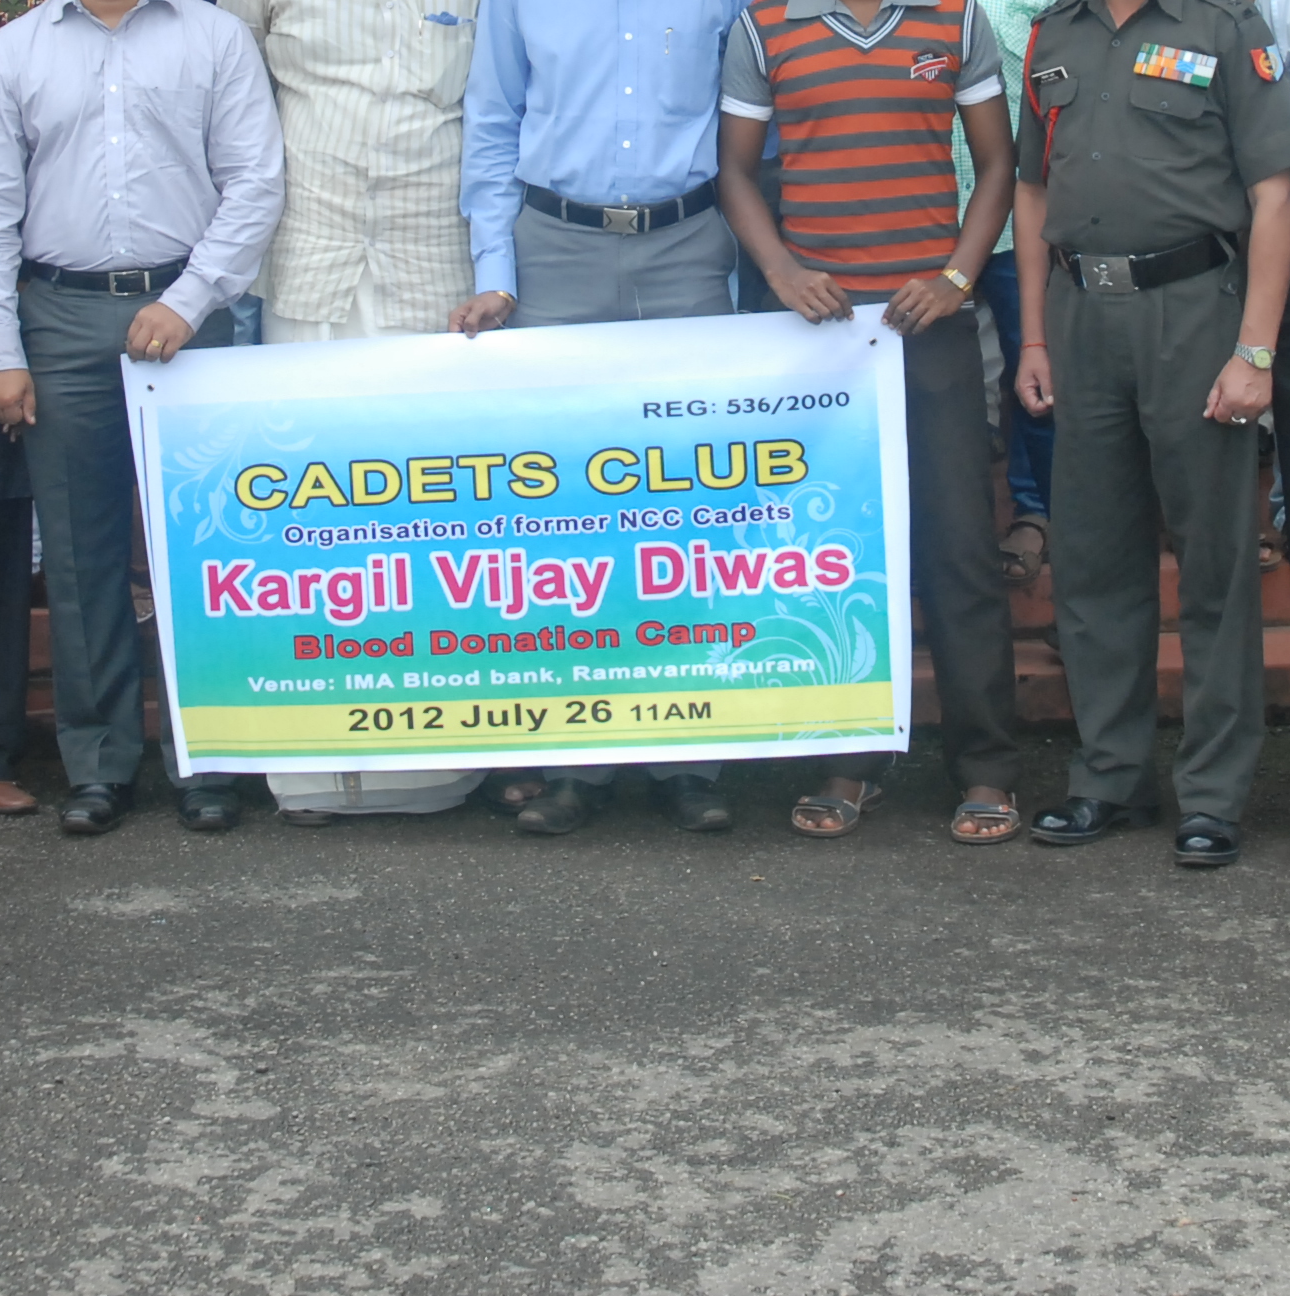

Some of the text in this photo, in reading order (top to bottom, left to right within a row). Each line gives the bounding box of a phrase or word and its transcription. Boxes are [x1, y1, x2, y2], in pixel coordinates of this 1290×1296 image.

[642, 391, 851, 419] REG: 536/2000
[234, 438, 809, 511] CADETS CLUB
[284, 504, 792, 547] Organisation of former NCC Cadets
[205, 542, 853, 623] Kargil Vijay Diwas
[293, 620, 757, 660] Blood Donation Camp
[247, 658, 816, 692] Venue: IMA Blood bank, Ramavarmapuram
[347, 699, 713, 732] 2012 July 26 11AM
